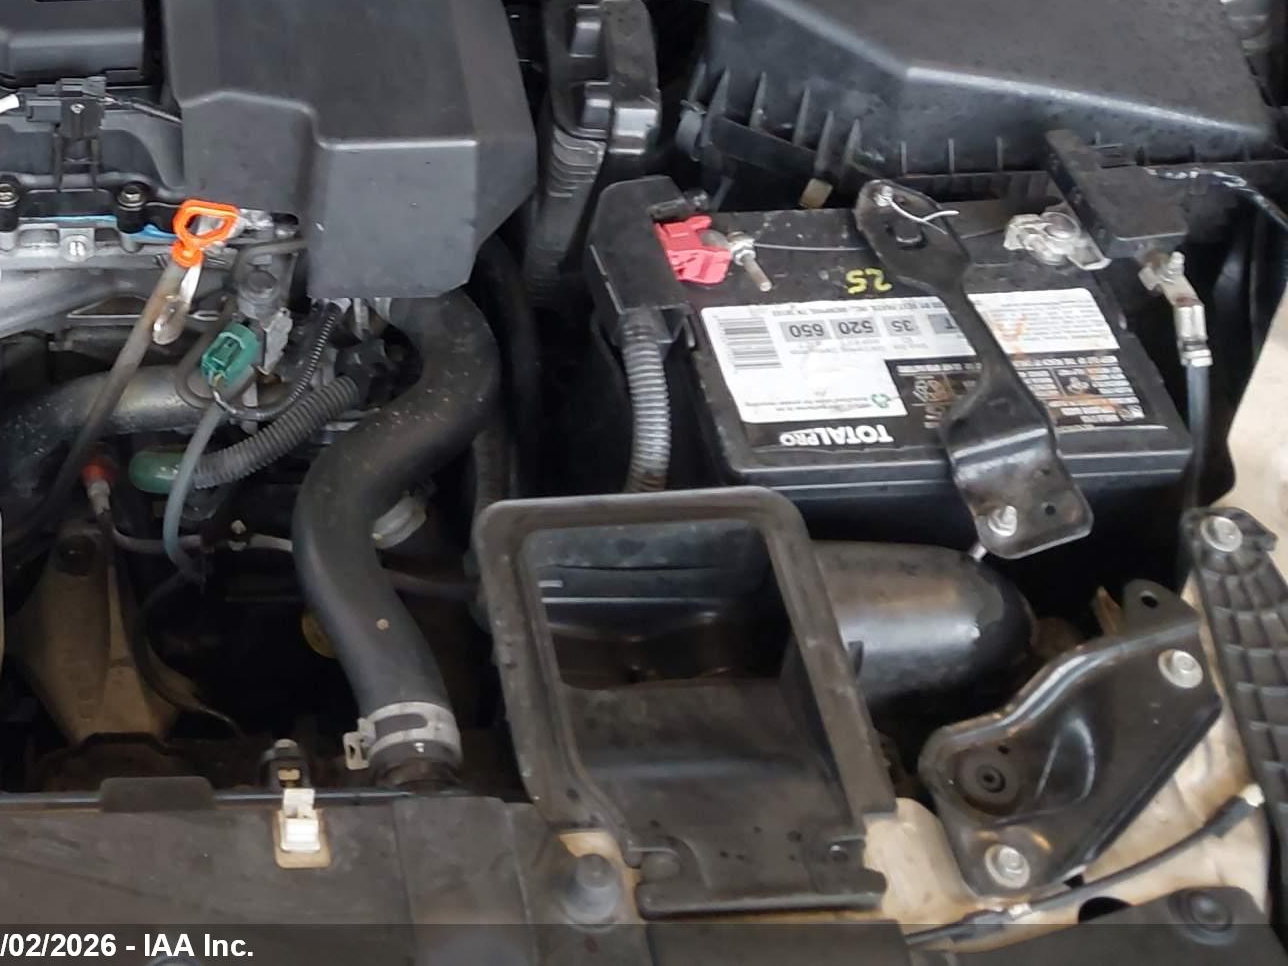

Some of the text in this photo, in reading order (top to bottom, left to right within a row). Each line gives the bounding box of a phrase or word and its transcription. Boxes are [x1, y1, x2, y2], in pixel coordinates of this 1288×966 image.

[789, 322, 825, 338] 650
[838, 320, 875, 335] 520
[892, 318, 915, 332] 35
[779, 424, 893, 447] TOTALPRO
